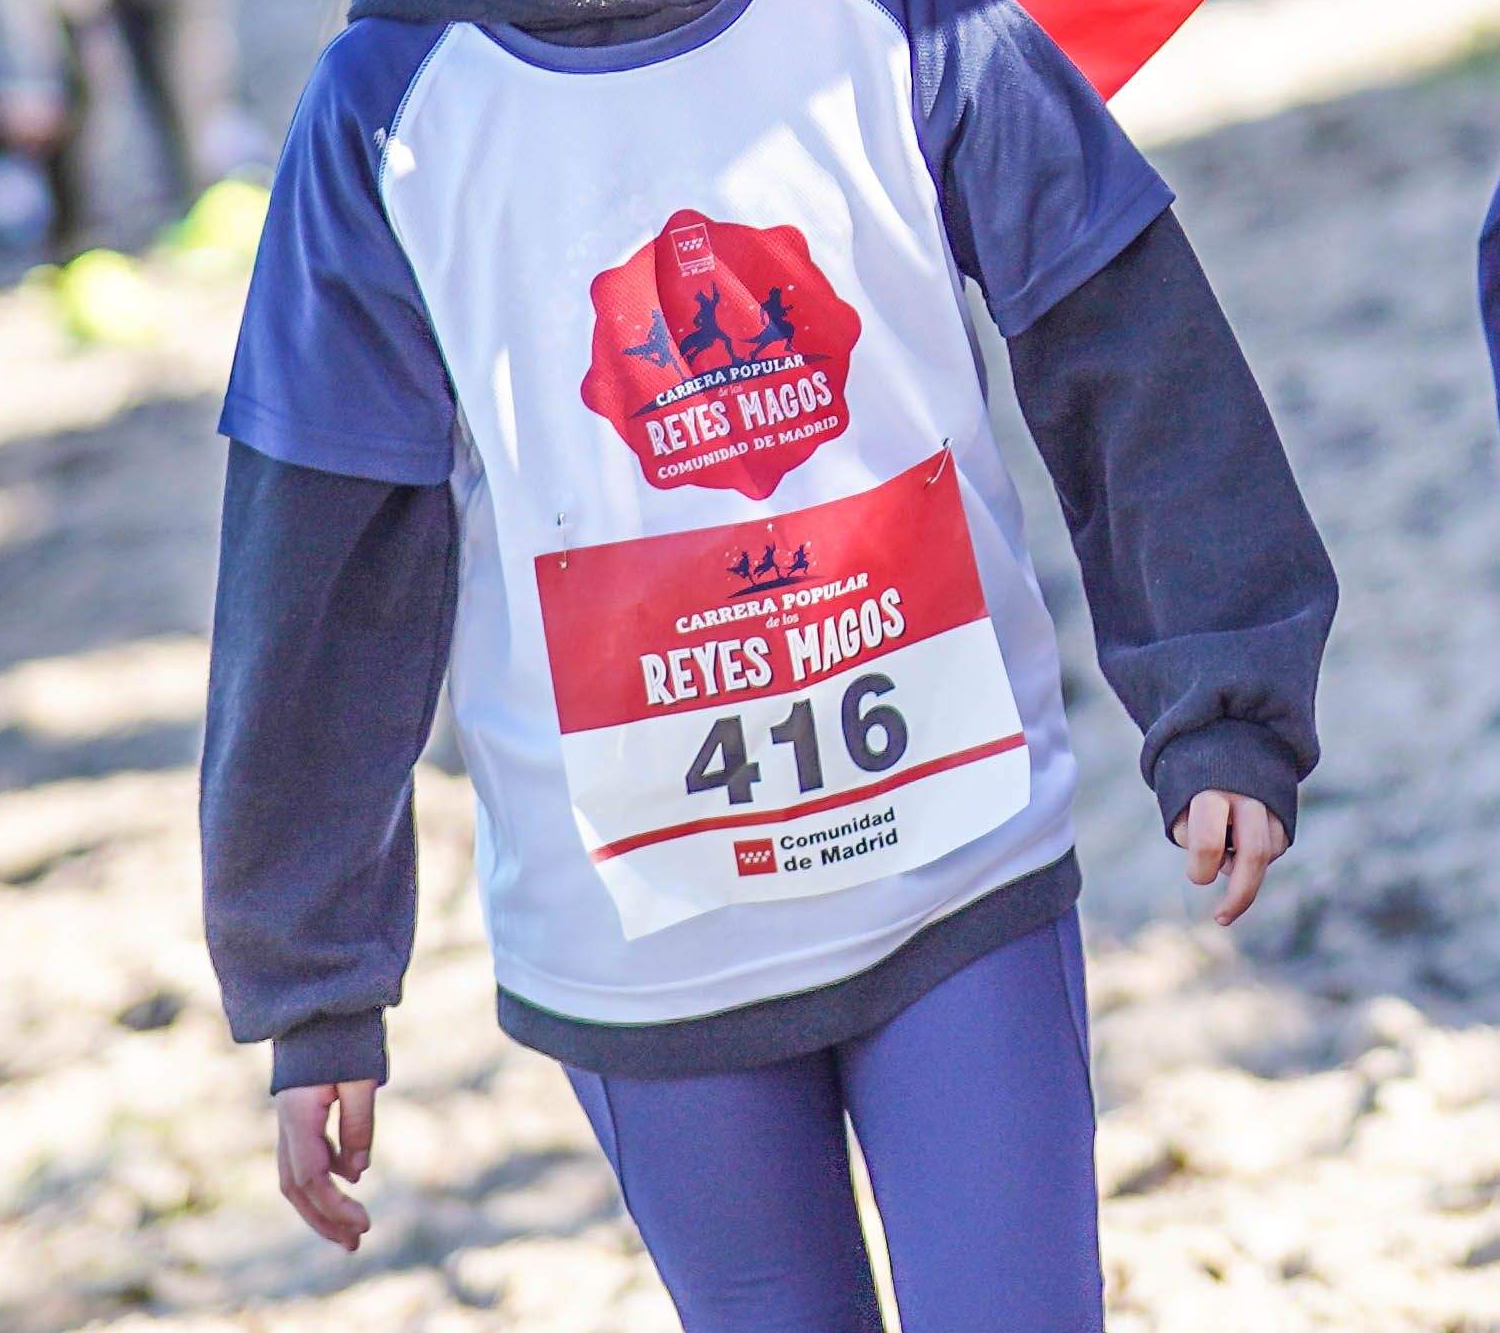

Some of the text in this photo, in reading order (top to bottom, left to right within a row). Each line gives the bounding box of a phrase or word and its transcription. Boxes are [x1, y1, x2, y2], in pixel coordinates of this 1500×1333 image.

[655, 353, 805, 407] CARRERA POPULAR
[645, 370, 833, 458] REYES MAGOS
[657, 415, 839, 480] COMUNIDAD DE MADRID
[675, 572, 869, 634] CARRERA POPULAR
[765, 611, 799, 630] de los
[639, 587, 907, 706] REYES MAGOS
[685, 672, 909, 805] 416
[780, 807, 896, 851] Comunidad
[783, 828, 899, 873] de Madrid
